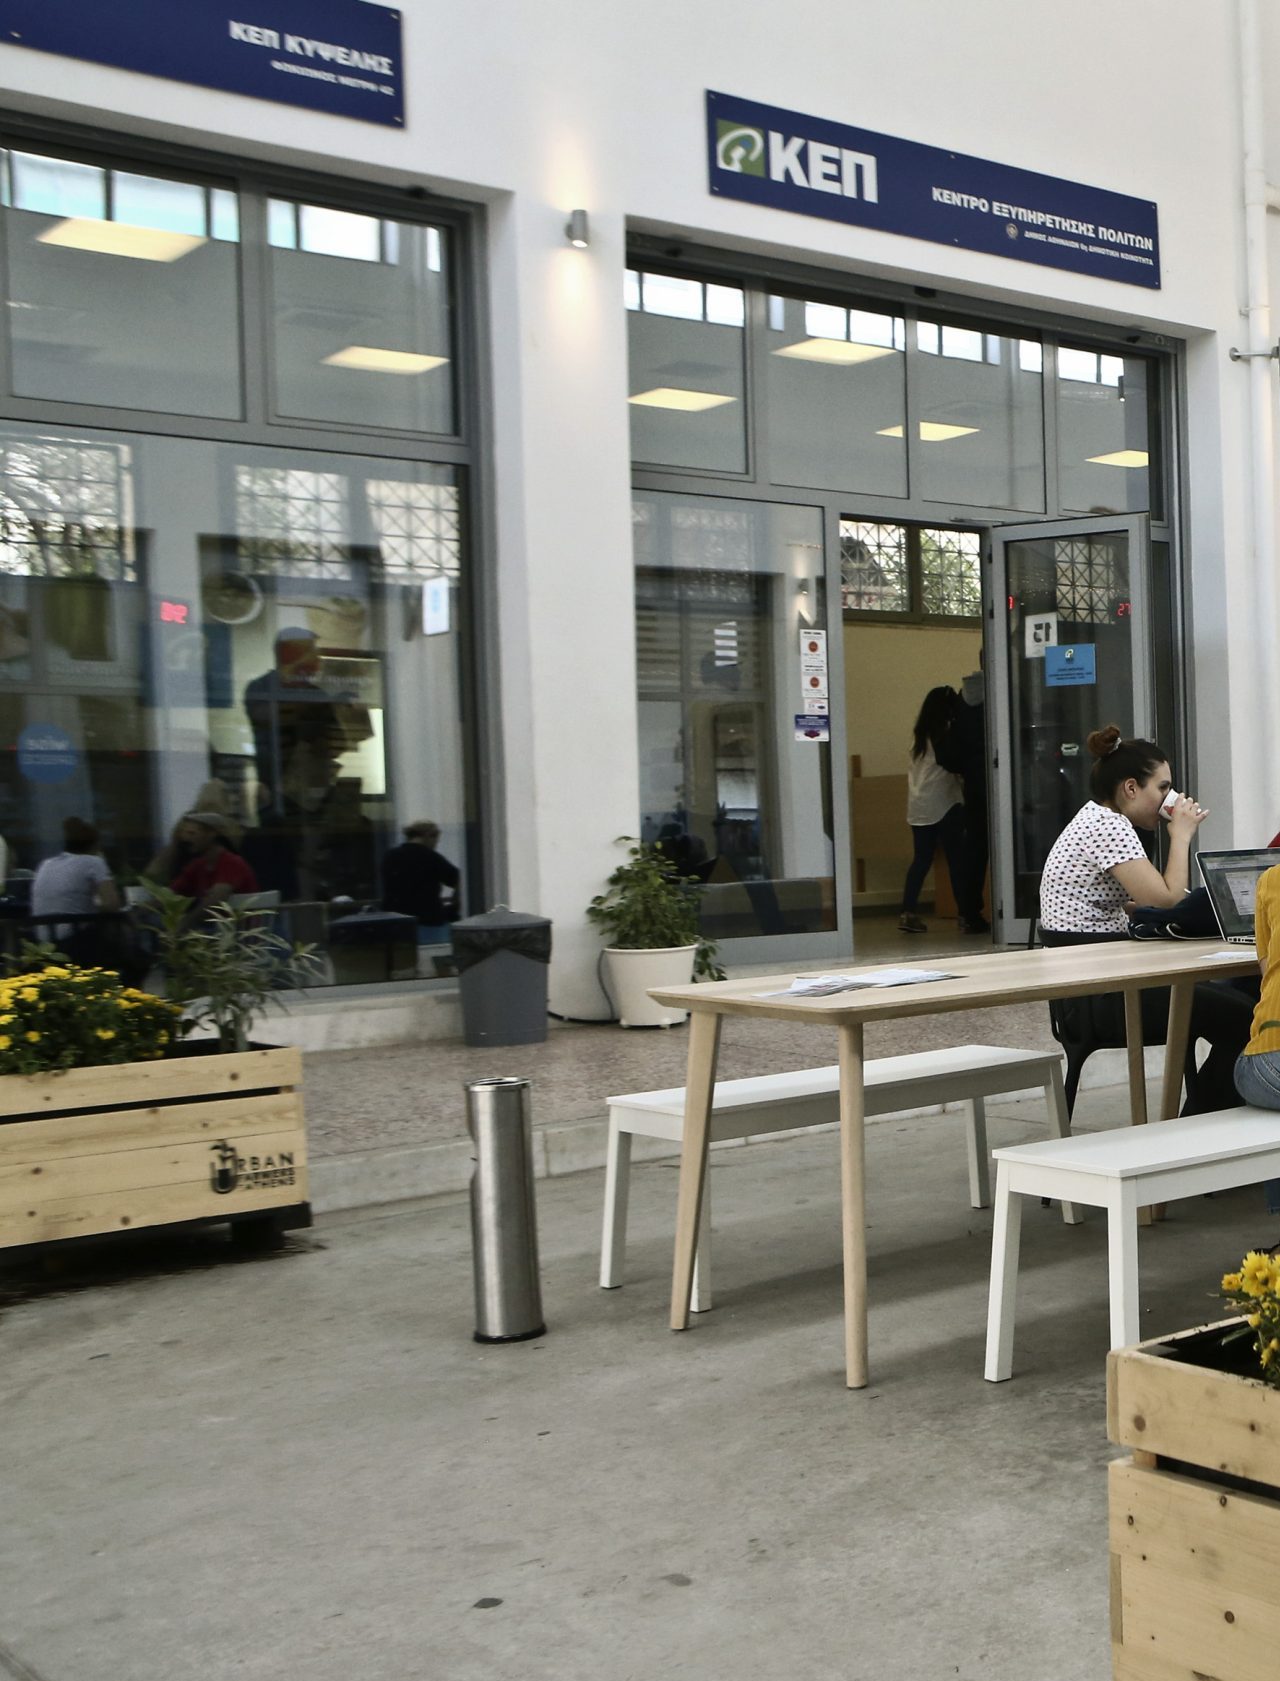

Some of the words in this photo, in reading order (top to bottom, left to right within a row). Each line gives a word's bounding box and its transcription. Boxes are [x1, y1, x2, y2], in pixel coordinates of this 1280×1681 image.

[229, 20, 280, 49] ΚΕΠ
[284, 33, 394, 76] ΚΥΨΕΛΗΣ
[768, 130, 879, 203] ΚΕΠ
[932, 187, 989, 213] ΚΕΝΤΡΟ
[992, 201, 1095, 237] ΕΞΥΠΗΡΕΤΗΣΗΣ
[1098, 226, 1153, 251] ΠΟΛΙΤΩΝ
